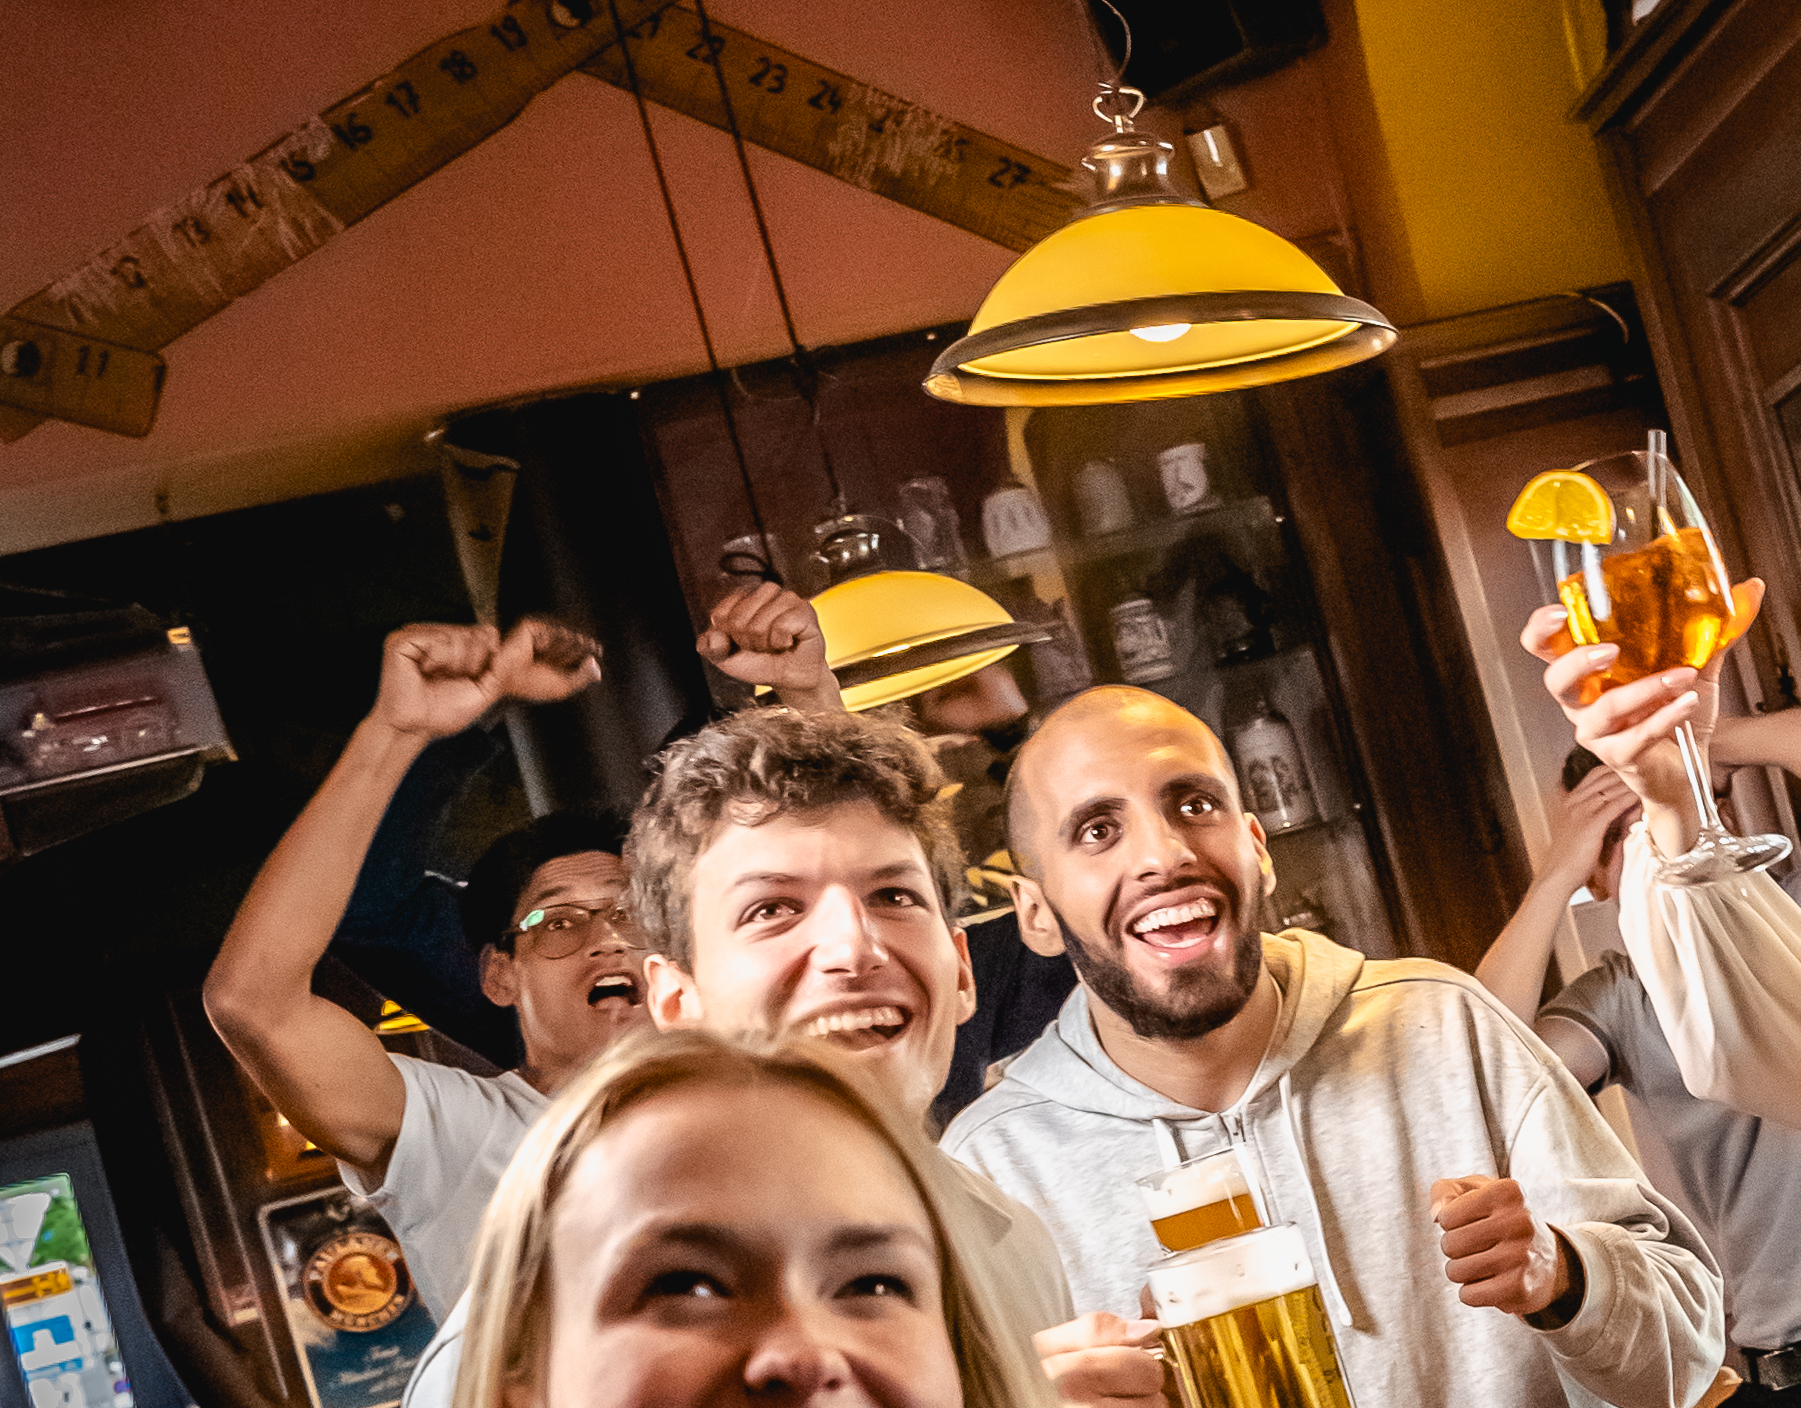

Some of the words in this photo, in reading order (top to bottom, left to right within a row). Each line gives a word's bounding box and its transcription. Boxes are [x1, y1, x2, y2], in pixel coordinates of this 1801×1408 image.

[330, 112, 373, 150] 16
[385, 80, 420, 118] 17
[440, 50, 478, 84] 18
[490, 14, 528, 51] 19
[750, 56, 788, 94] 23
[988, 157, 1032, 188] 27
